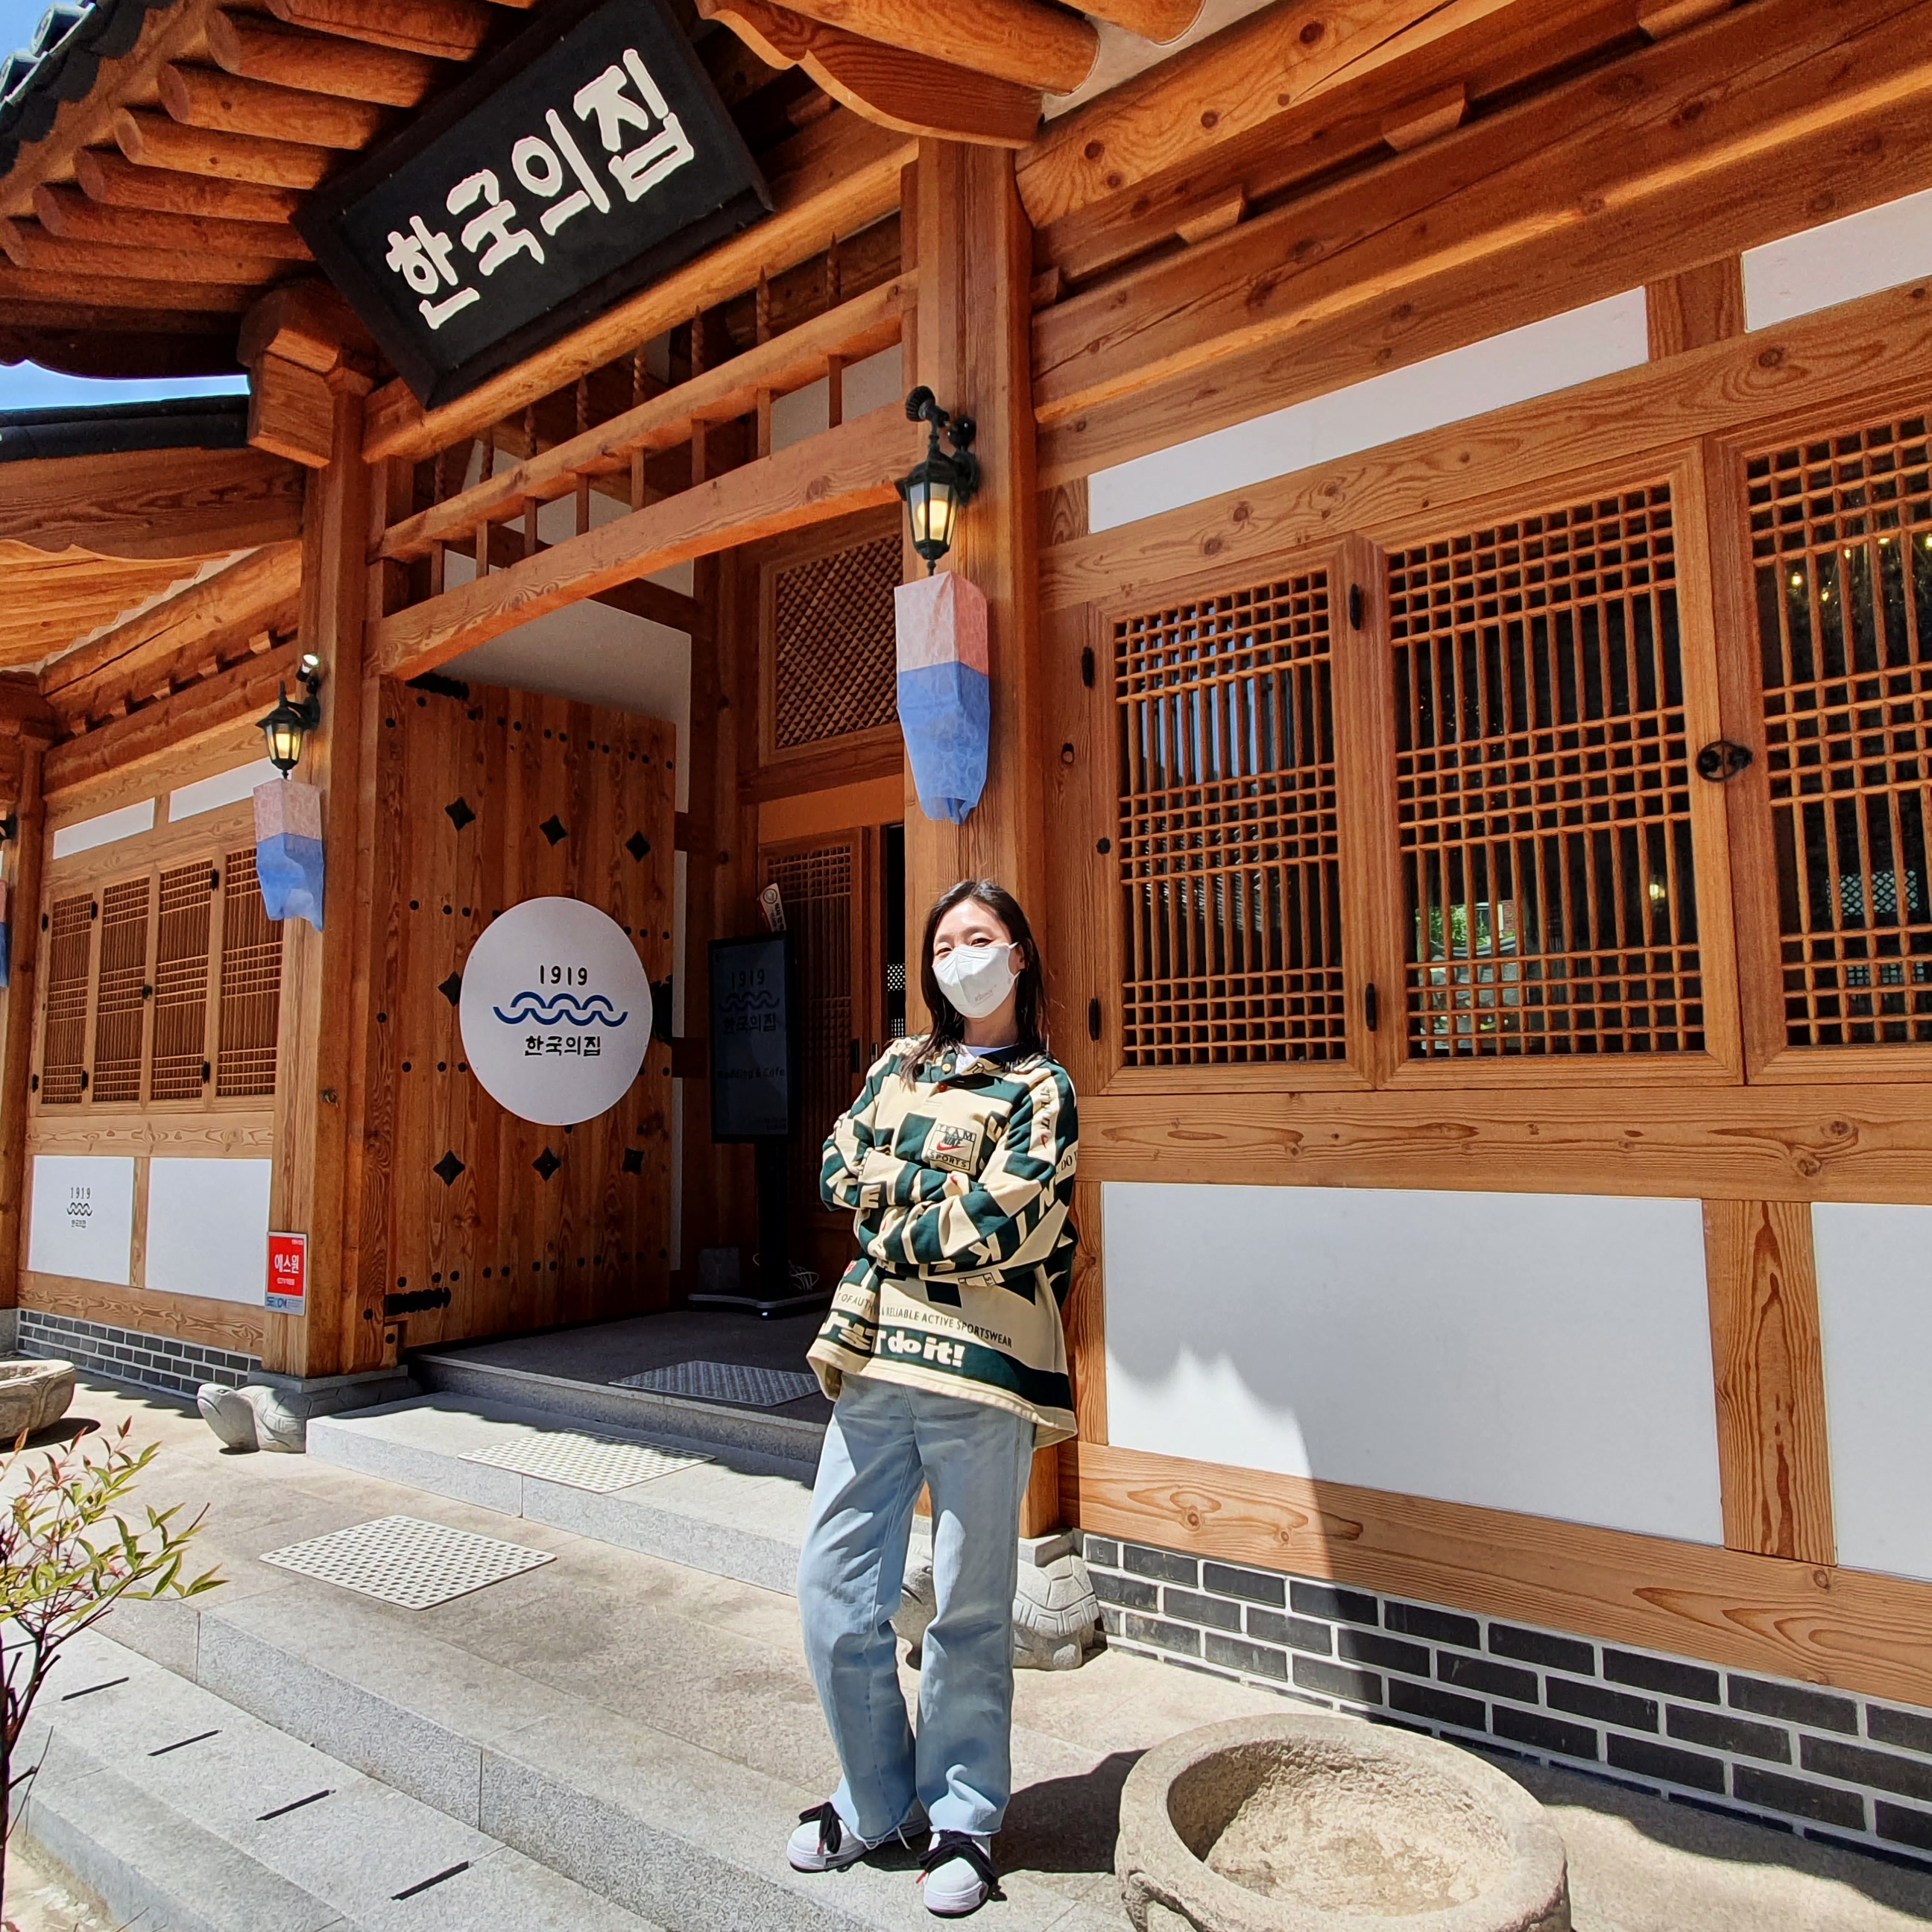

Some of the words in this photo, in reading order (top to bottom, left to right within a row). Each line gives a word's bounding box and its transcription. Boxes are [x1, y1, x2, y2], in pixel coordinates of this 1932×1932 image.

[385, 48, 695, 330] 한국의집
[540, 965, 587, 985] 1919
[730, 968, 765, 989] 1919
[524, 1035, 601, 1056] 한국의집
[936, 1123, 976, 1142] TEAM
[942, 1134, 963, 1146] NIKE
[929, 1151, 967, 1169] SPORTS
[70, 1186, 91, 1200] 1919
[841, 1293, 853, 1304] OF
[886, 1306, 920, 1322] RELIABLE
[921, 1313, 954, 1328] ACTIVE
[956, 1319, 1013, 1348] SPORTSWEAR
